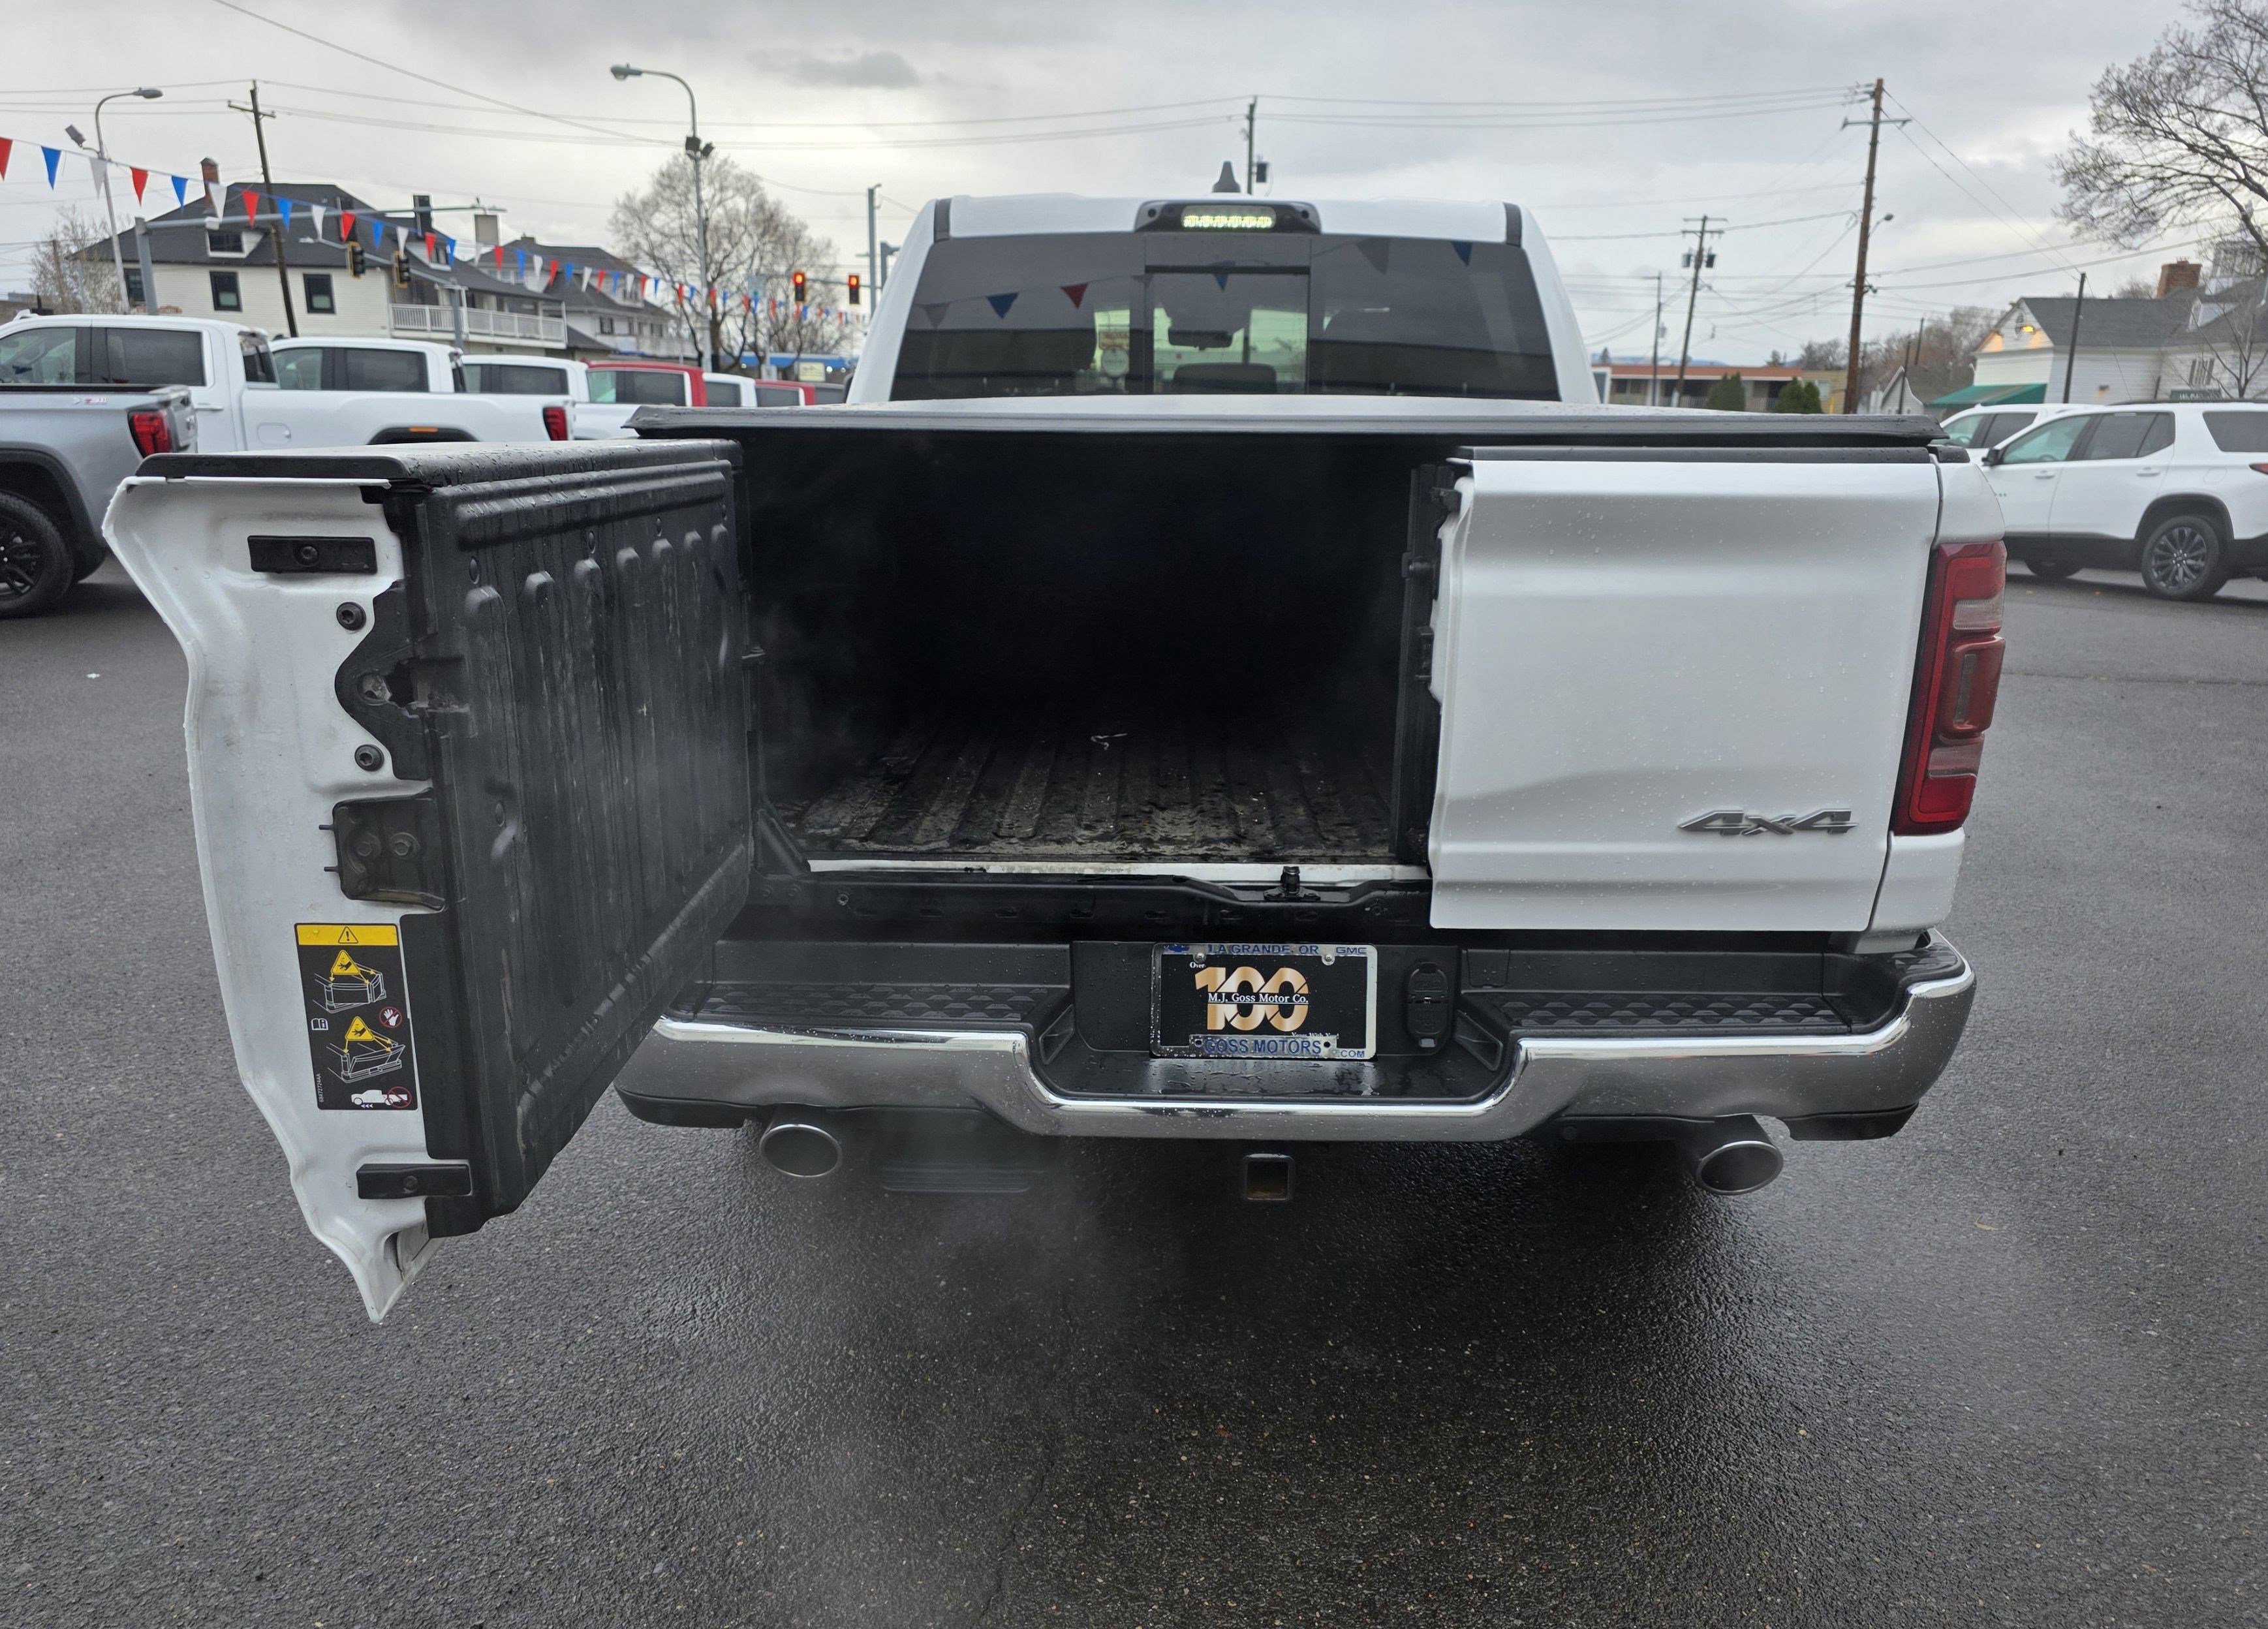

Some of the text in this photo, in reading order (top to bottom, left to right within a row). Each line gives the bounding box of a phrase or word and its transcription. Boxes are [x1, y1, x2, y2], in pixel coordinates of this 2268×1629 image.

[1208, 944, 1227, 954] LA
[1299, 945, 1319, 954] OR
[1195, 966, 1309, 1031] 100
[1209, 993, 1309, 1002] M.J. Goss Motor Co.
[1204, 1038, 1322, 1055] GOSS MOTORS
